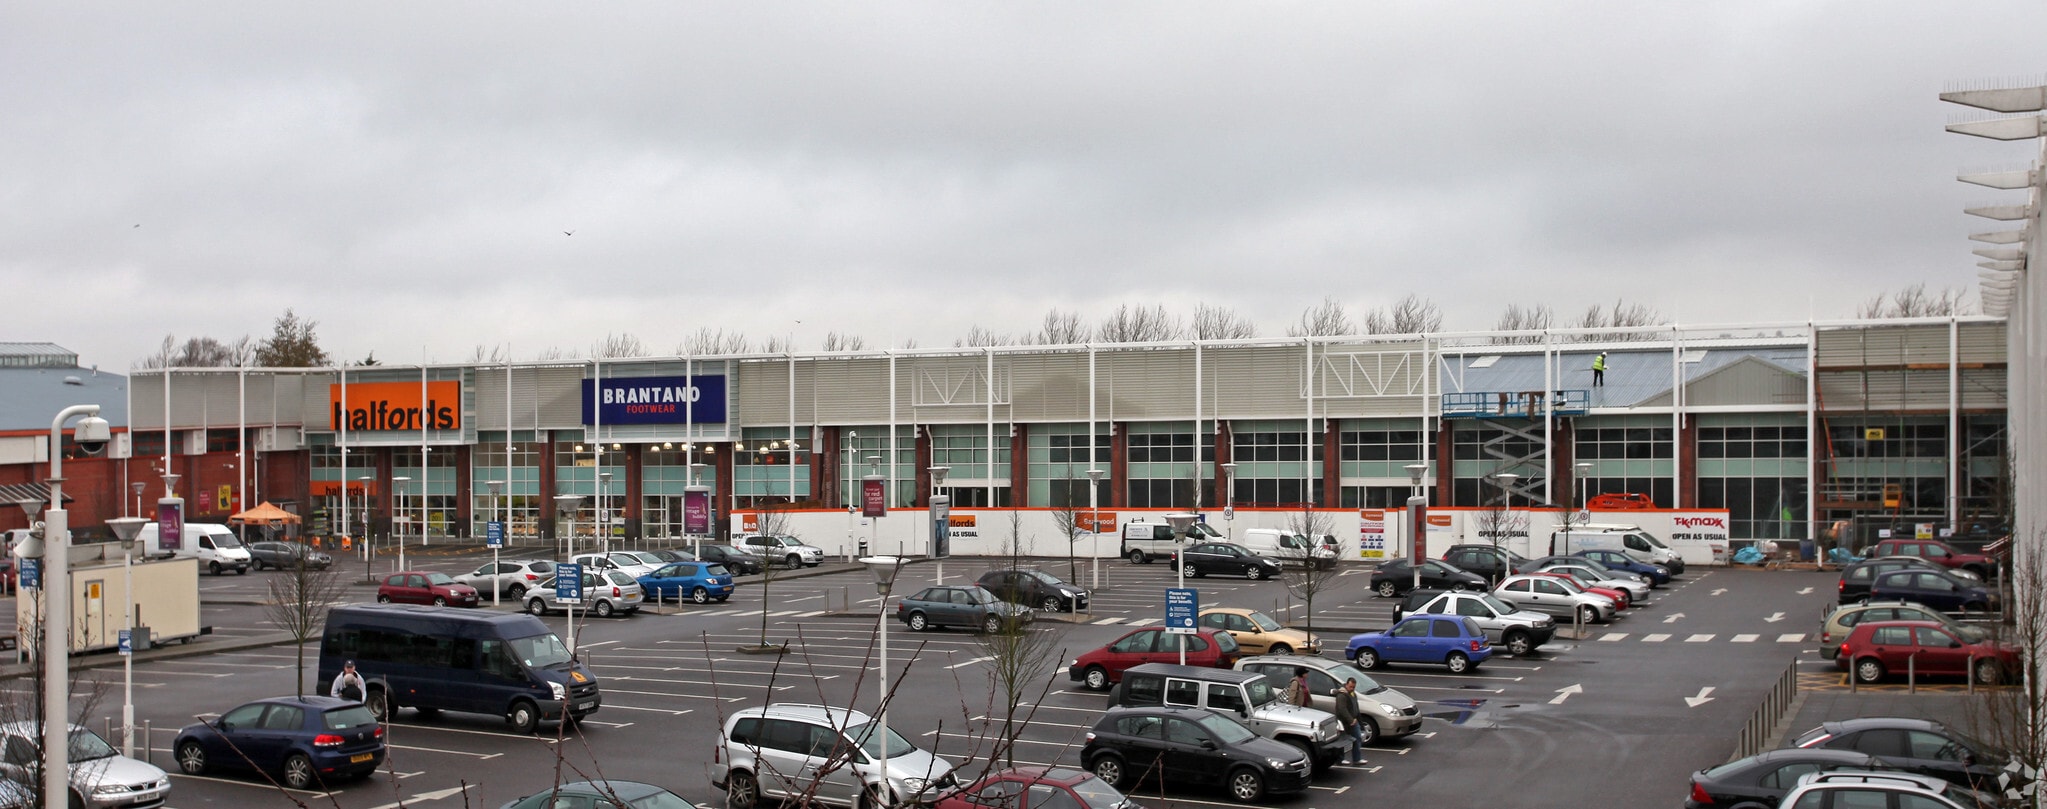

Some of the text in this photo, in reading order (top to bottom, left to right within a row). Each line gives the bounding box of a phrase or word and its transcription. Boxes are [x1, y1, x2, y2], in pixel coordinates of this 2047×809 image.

[603, 386, 701, 404] BRANTANO
[334, 400, 454, 431] halfords
[626, 404, 675, 414] FOOTWEAR
[948, 519, 976, 527] lfords
